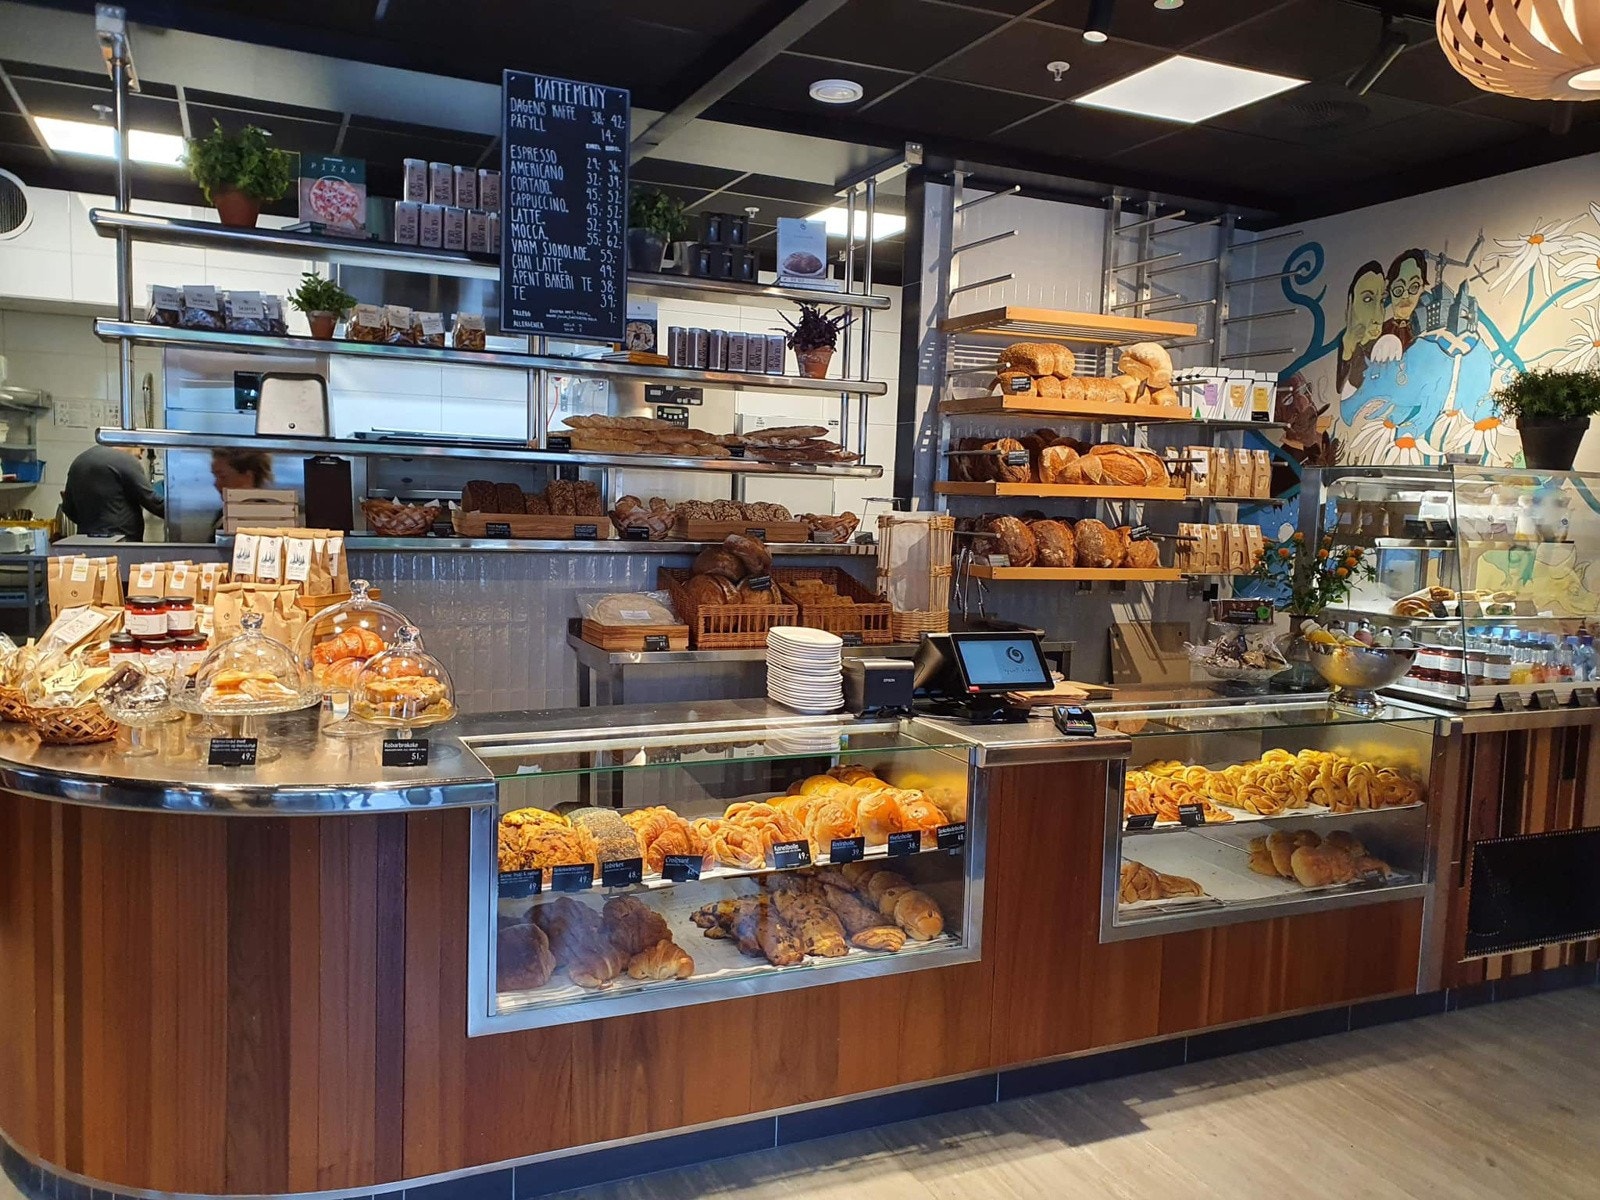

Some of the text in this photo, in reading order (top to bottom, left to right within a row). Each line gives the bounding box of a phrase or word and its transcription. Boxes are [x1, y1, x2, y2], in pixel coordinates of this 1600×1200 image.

[535, 77, 606, 109] KAFFEMENY
[510, 97, 546, 116] DAGENS
[552, 104, 577, 120] KAFFE
[510, 113, 546, 132] PÅFYLL
[510, 144, 557, 164] ESPRESSO
[510, 160, 564, 180] AMERICANO
[511, 238, 537, 254] VARM
[512, 254, 532, 270] CHAI
[512, 269, 540, 286] ÅPENT
[544, 272, 574, 290] BAKERI
[581, 276, 593, 292] TE
[512, 285, 526, 301] TE
